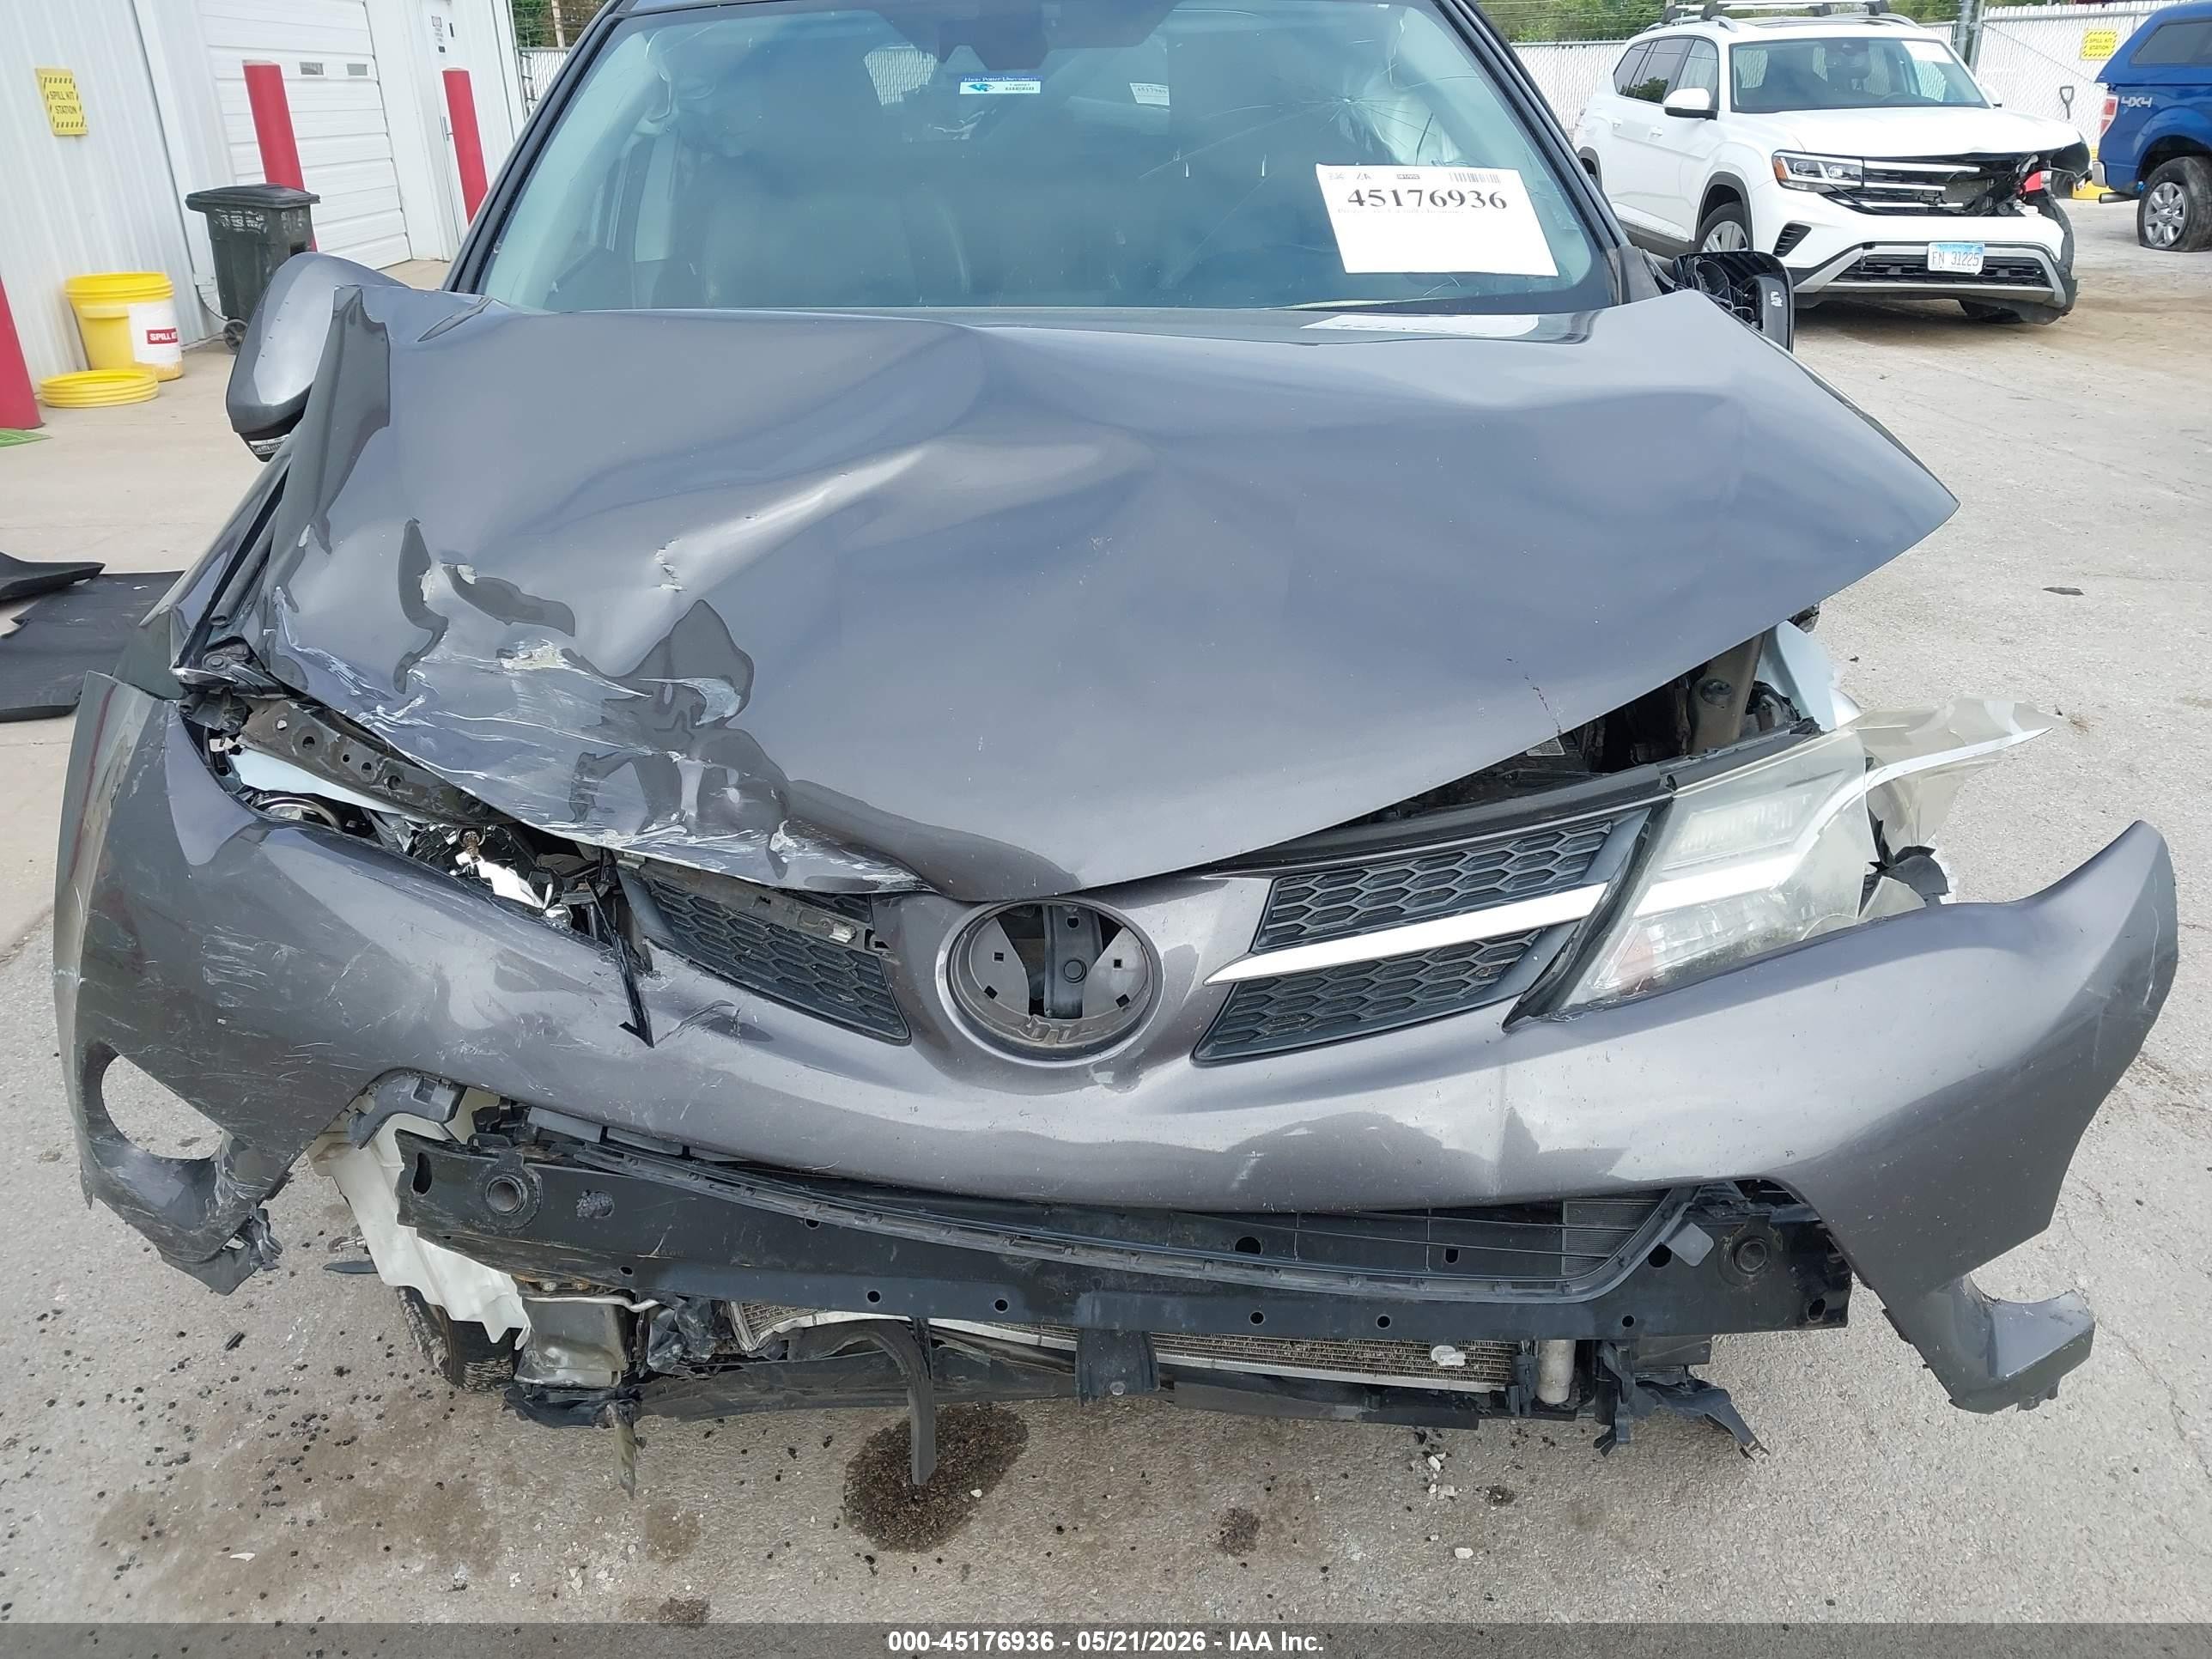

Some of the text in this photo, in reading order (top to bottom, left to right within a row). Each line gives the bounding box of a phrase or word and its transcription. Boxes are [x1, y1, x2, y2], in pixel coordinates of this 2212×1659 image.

[49, 90, 66, 100] SPILL
[55, 105, 77, 115] STATION
[1347, 188, 1508, 210] 45176936
[1932, 251, 1979, 267] FN 31225
[149, 332, 171, 342] SPILL
